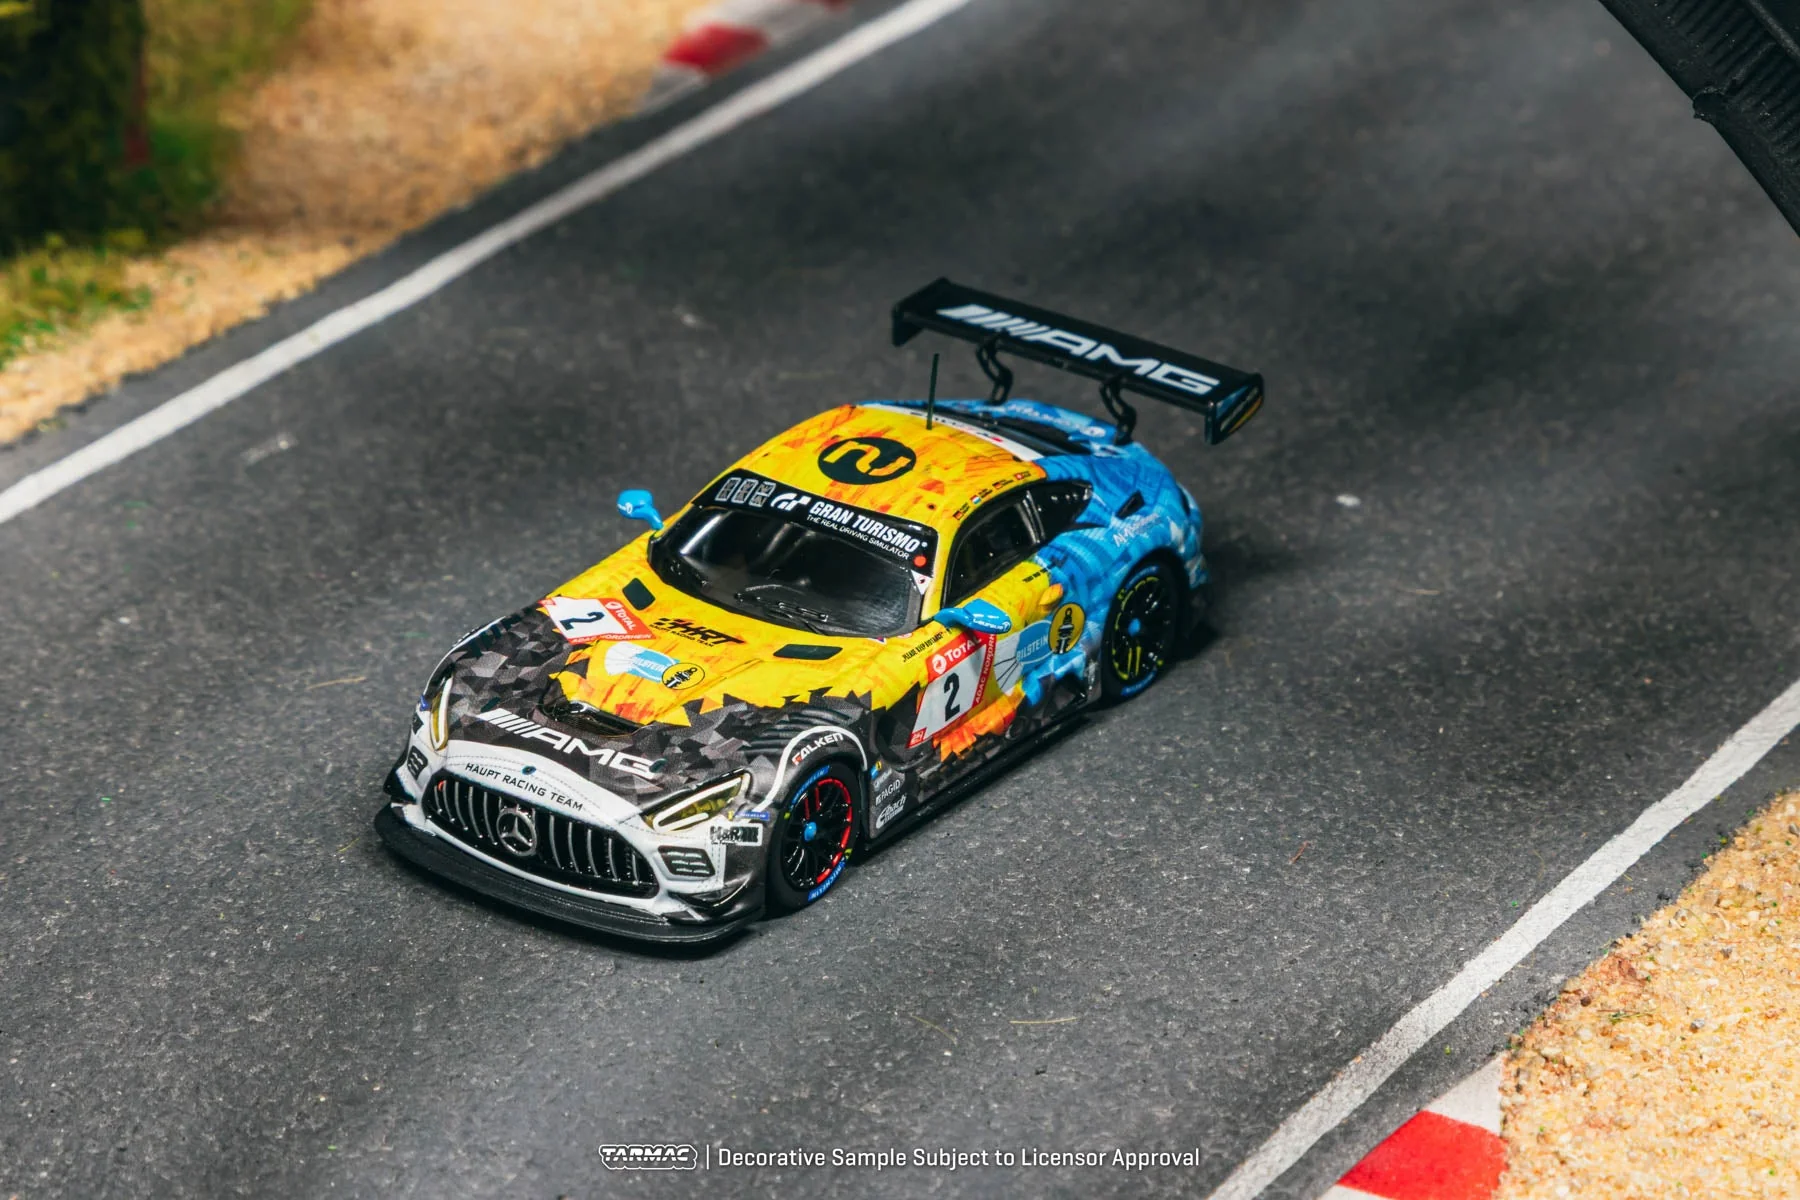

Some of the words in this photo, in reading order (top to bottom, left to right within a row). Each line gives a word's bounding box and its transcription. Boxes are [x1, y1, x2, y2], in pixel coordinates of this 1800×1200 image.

[806, 514, 822, 525] THE
[820, 519, 839, 531] REAL
[838, 526, 869, 542] DRIVING
[868, 537, 910, 560] SIMULATOR
[809, 501, 855, 525] GRAN
[852, 514, 921, 553] TURISMO
[559, 611, 606, 631] 2
[614, 607, 637, 632] TOTAL
[975, 676, 987, 704] ADAC
[983, 634, 998, 675] NORDRH
[1016, 634, 1050, 662] BILSTEIN
[943, 672, 961, 722] 2
[791, 732, 844, 766] FALKEN
[465, 762, 501, 780] HAUPT
[501, 774, 547, 797] RACING
[550, 791, 583, 811] TEAM
